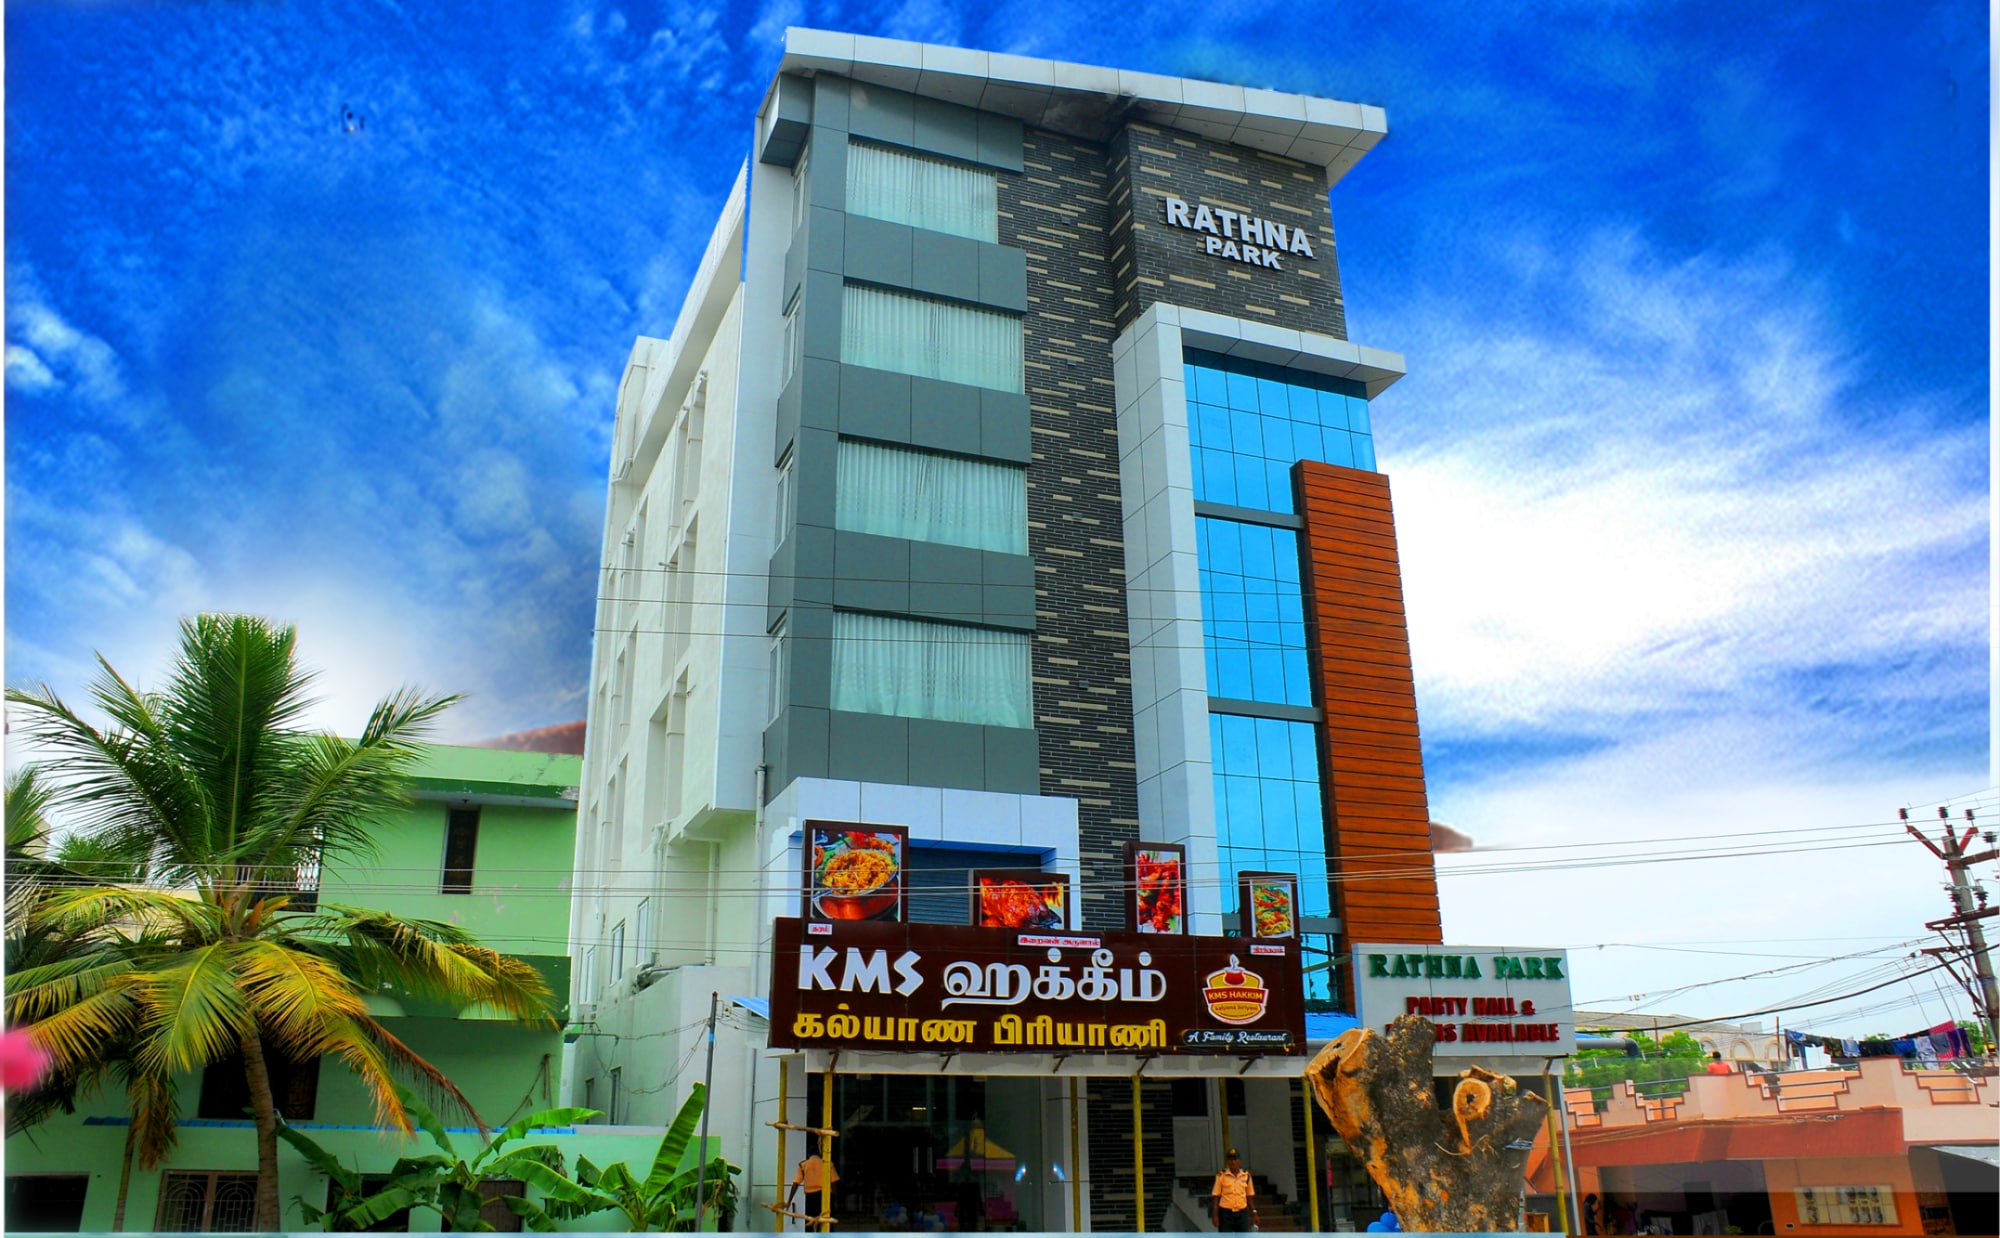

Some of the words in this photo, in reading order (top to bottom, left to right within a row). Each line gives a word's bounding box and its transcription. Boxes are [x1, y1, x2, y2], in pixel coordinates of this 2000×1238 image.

[1166, 197, 1314, 258] RATHNA
[1206, 235, 1282, 271] PARK
[798, 944, 924, 998] KMS
[941, 947, 1167, 1011] ஹக்கீம்
[1368, 953, 1482, 979] RATHNA
[1493, 955, 1565, 980] PARK
[1208, 991, 1228, 1000] KMS
[1229, 990, 1263, 1001] HAKKIM
[1406, 997, 1468, 1016] PARTY
[1472, 997, 1518, 1016] HALL
[1521, 1000, 1536, 1016] &
[793, 1003, 978, 1044] கல்யாண
[993, 1013, 1167, 1048] பிரியாணி
[1187, 1031, 1199, 1043] A
[1201, 1031, 1234, 1044] Family
[1236, 1031, 1288, 1045] Restaurant
[1462, 1023, 1560, 1043] AVAILABLE
